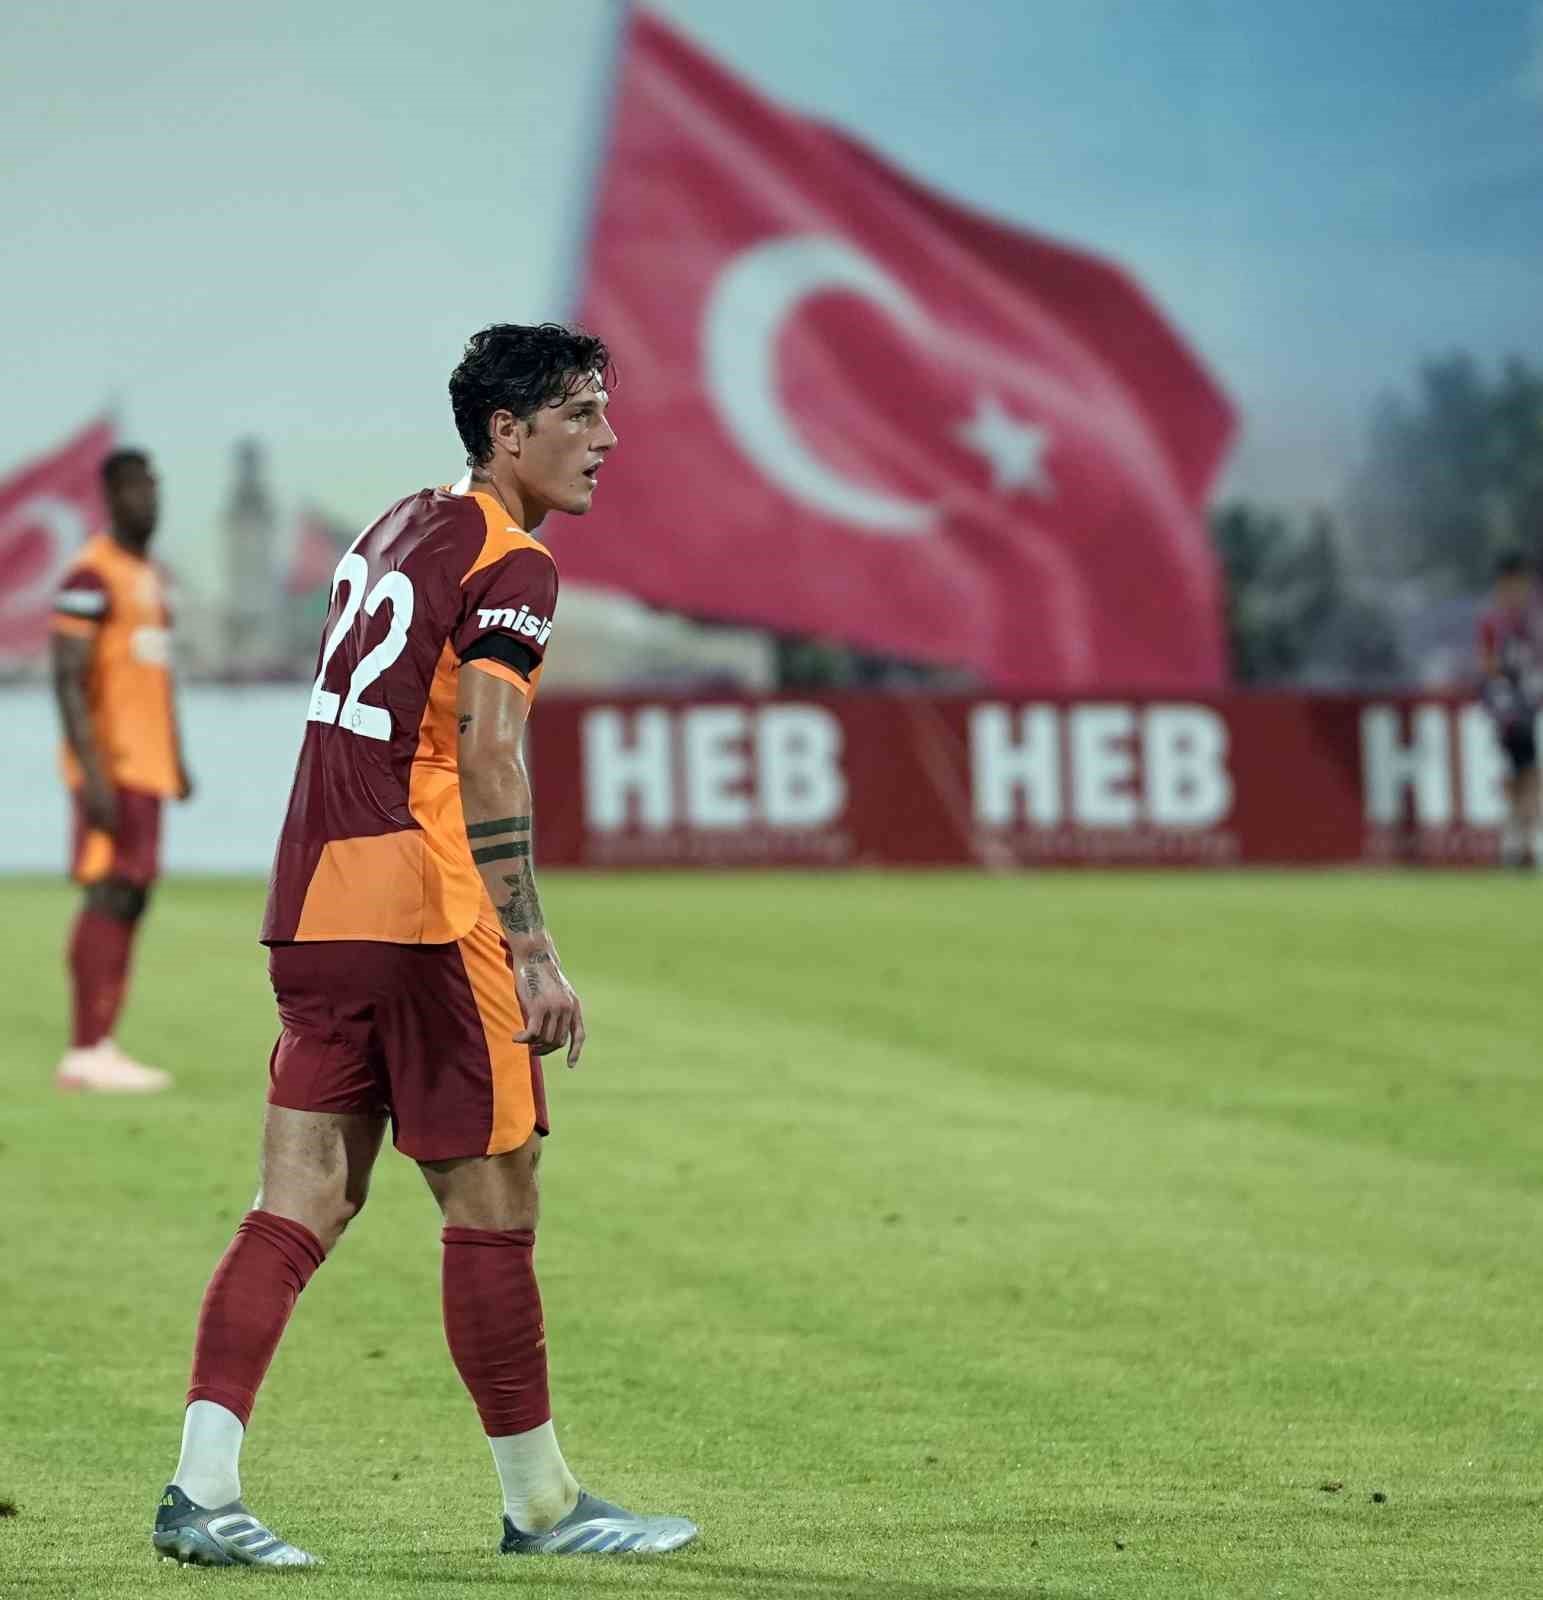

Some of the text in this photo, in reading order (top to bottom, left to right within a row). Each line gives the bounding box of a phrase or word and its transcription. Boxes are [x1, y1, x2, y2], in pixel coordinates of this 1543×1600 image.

[306, 552, 415, 741] 22
[583, 704, 846, 829] HEB
[970, 704, 1231, 827] HEB
